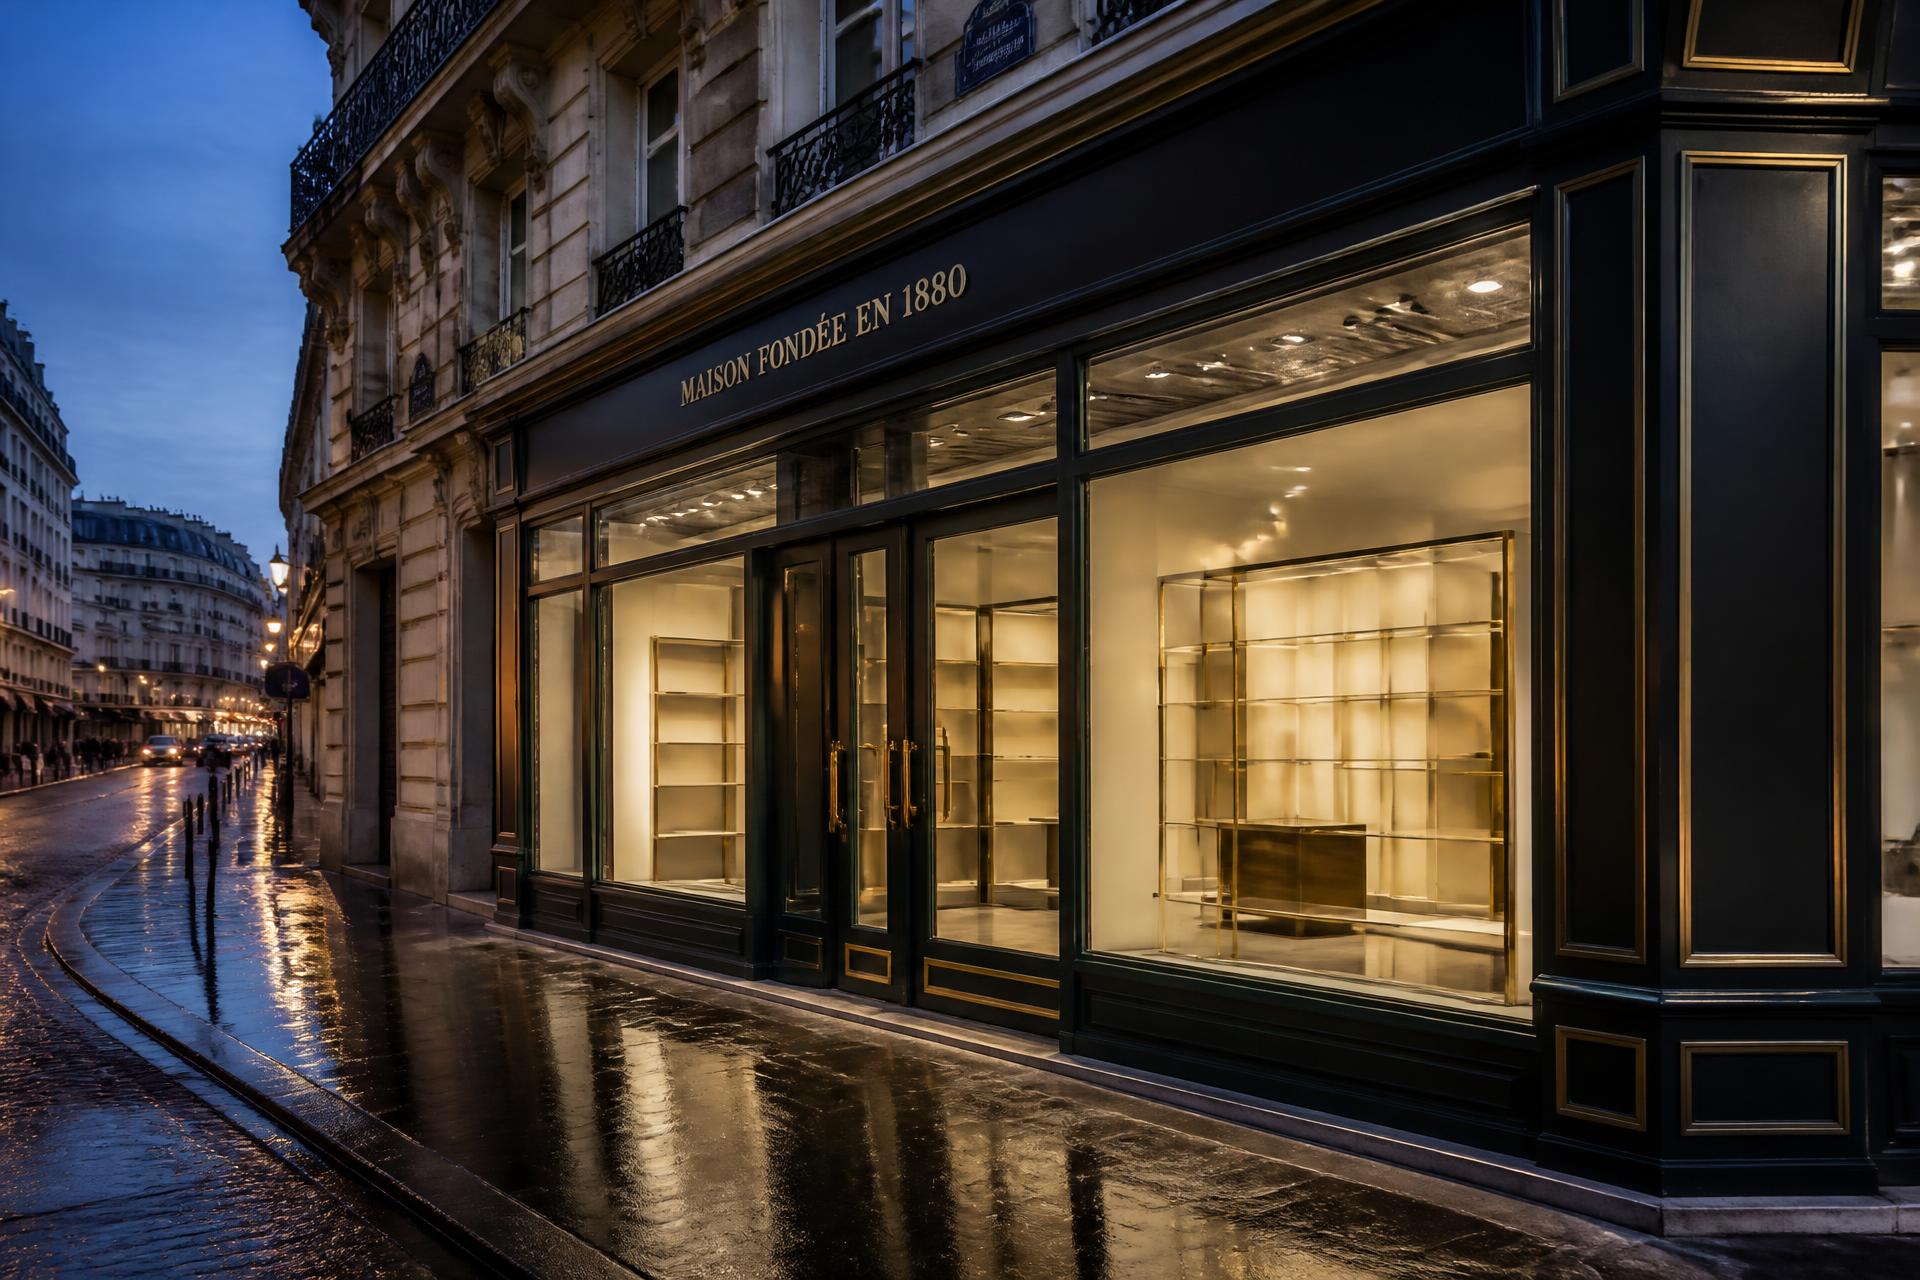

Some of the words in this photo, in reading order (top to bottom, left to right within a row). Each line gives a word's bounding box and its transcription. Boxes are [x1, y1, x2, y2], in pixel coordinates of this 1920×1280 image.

[680, 353, 751, 407] MAISON
[758, 312, 847, 376] FONDÉE
[856, 292, 892, 337] EN
[902, 263, 967, 318] 1880
